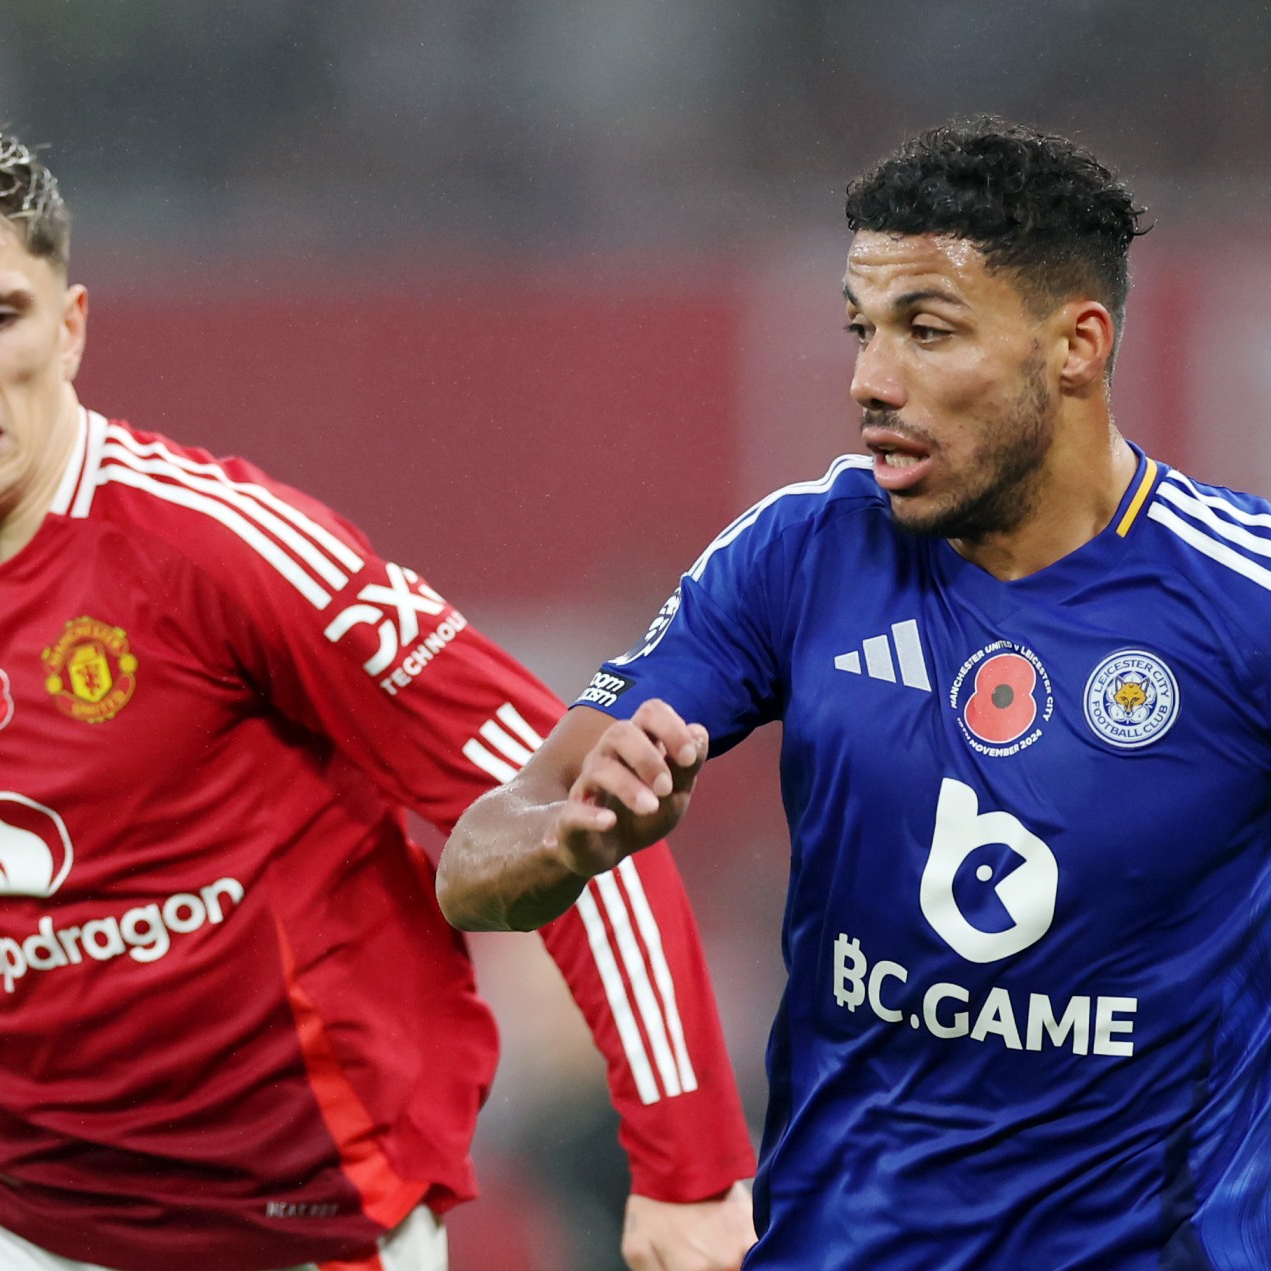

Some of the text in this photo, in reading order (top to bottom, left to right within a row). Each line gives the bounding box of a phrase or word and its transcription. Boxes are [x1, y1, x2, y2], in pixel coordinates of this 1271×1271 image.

[949, 649, 985, 709] MANCHESTER
[1020, 646, 1052, 695] LEICESTER
[1042, 696, 1054, 722] CITY
[1094, 659, 1171, 699] LEICESTER CITY
[1092, 700, 1169, 738] FOOTBALL CLUB
[969, 728, 1044, 758] NOVEMBER 2024
